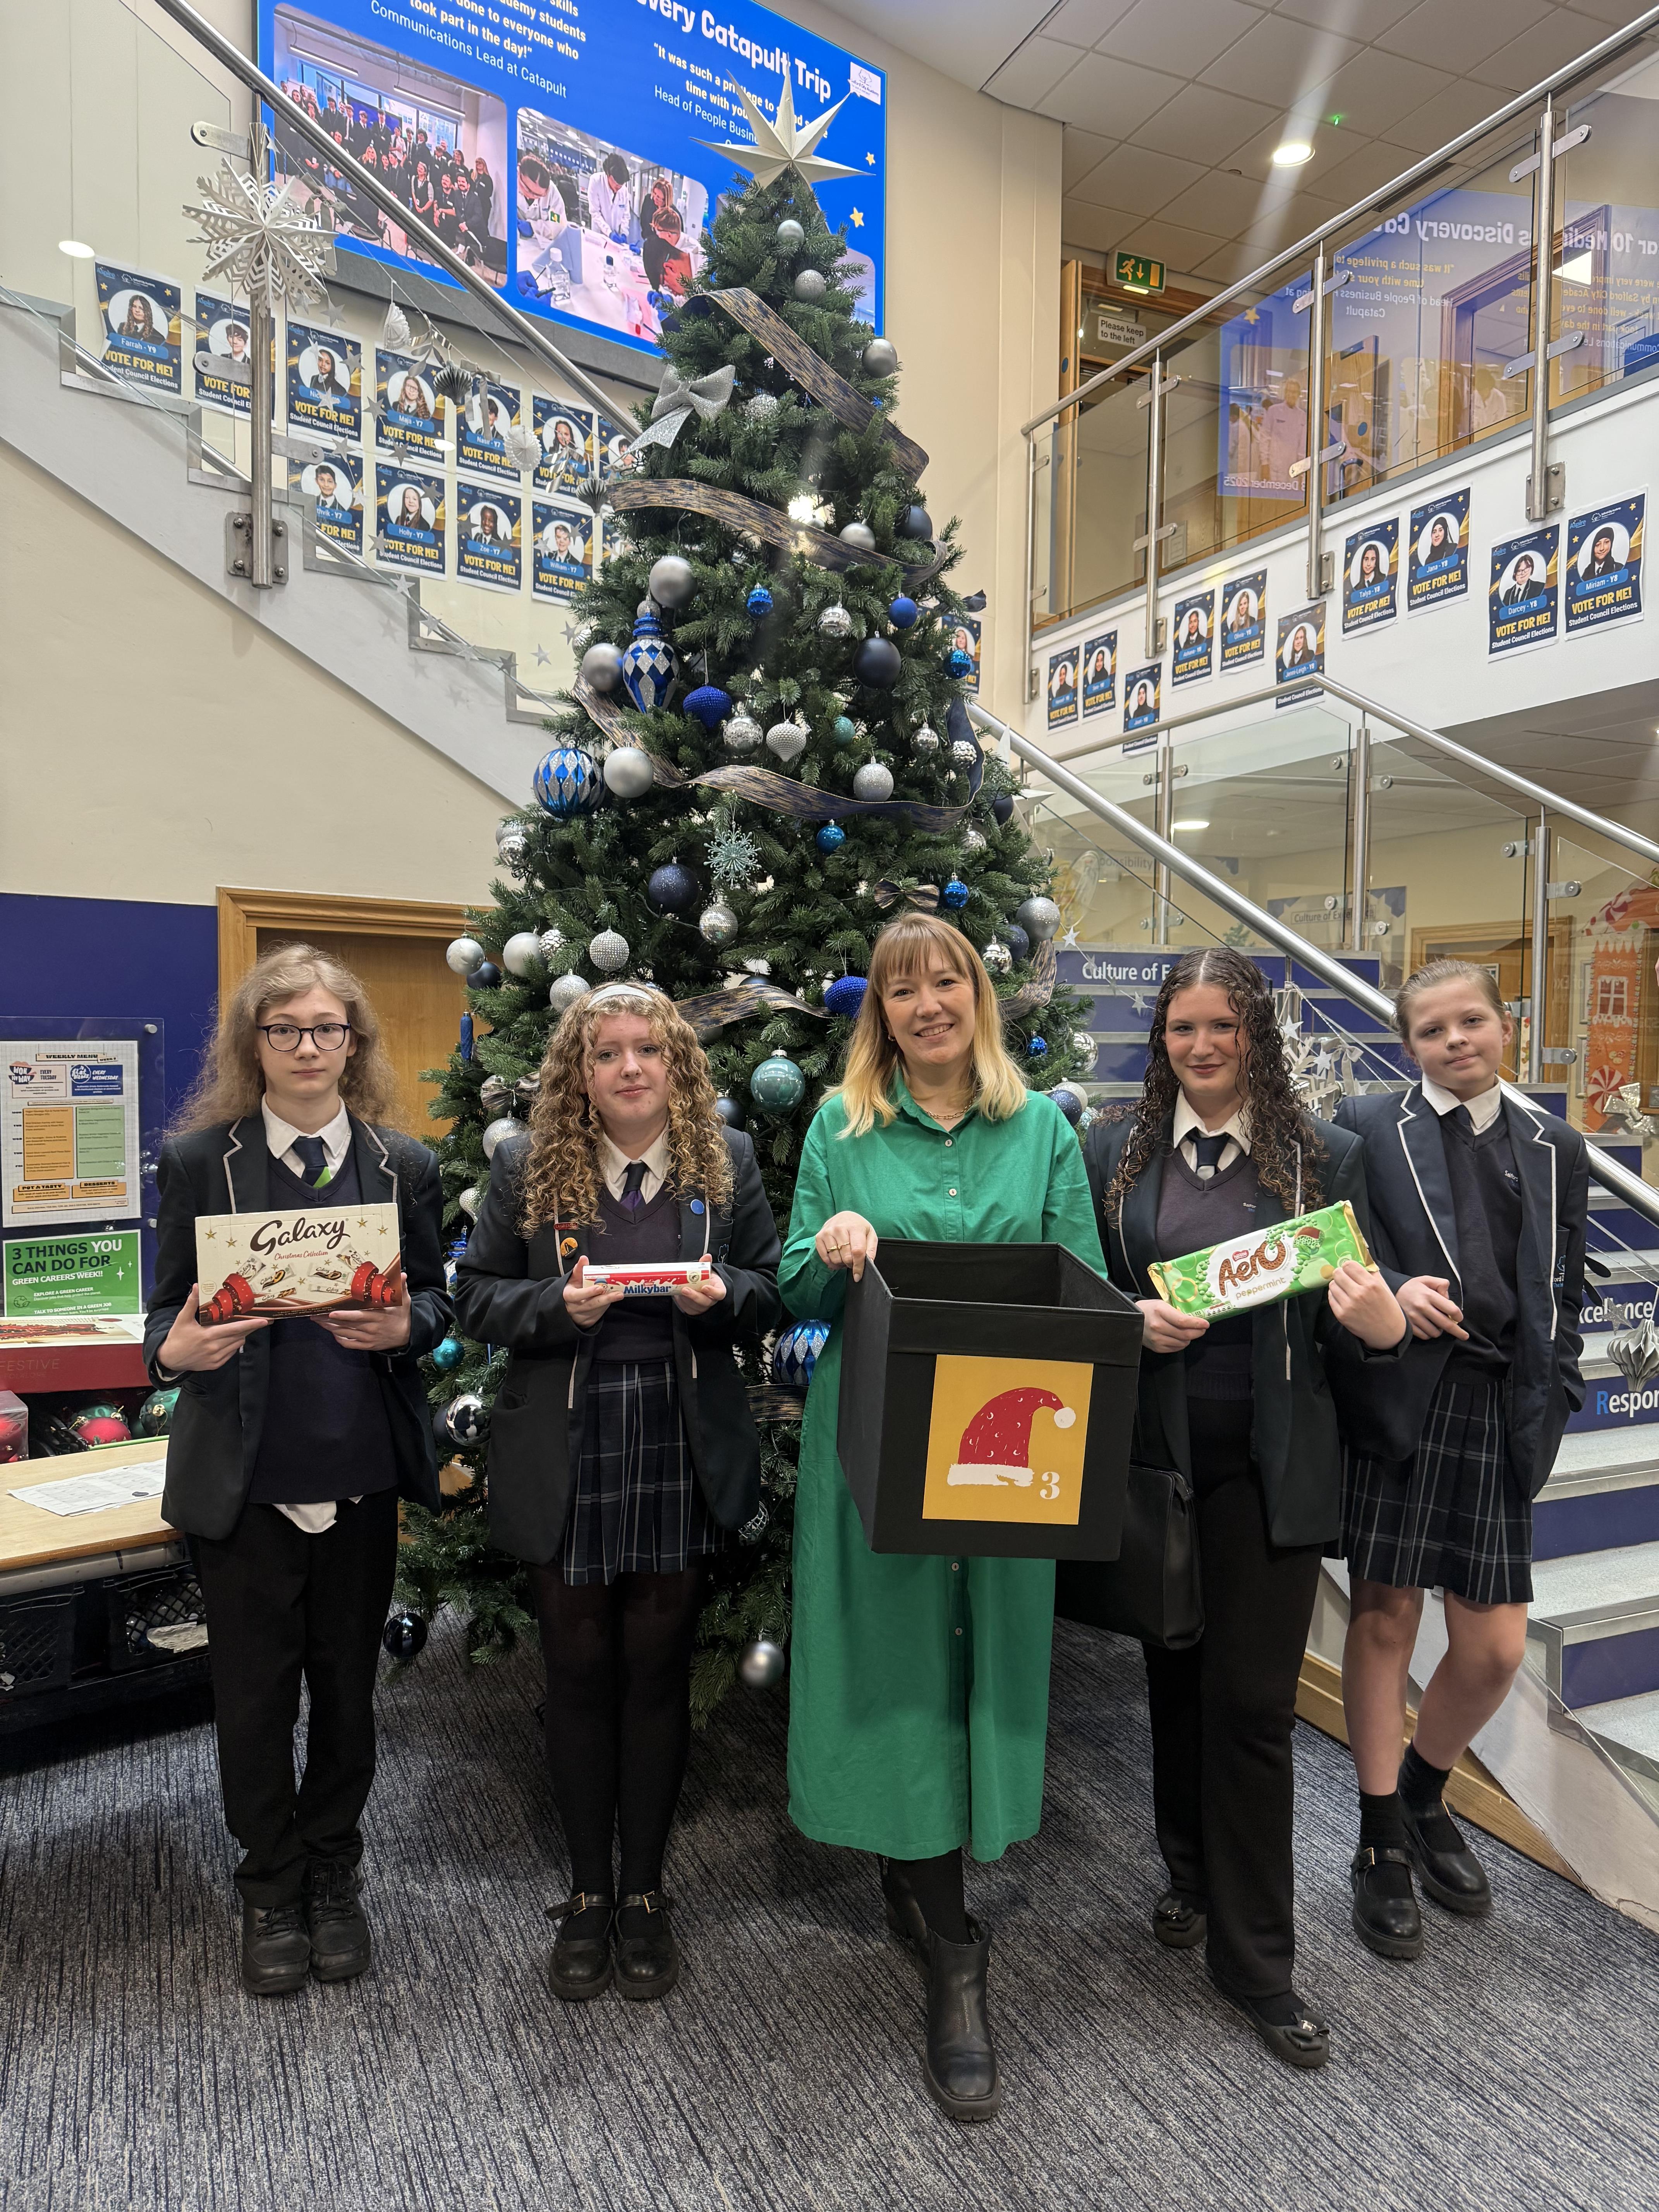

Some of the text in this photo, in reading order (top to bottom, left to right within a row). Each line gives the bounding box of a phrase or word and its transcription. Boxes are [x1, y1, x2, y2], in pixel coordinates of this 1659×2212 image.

[440, 10, 465, 30] part
[467, 19, 479, 36] in
[482, 27, 501, 46] the
[488, 7, 500, 23] to
[503, 17, 554, 48] everyone
[556, 41, 579, 59] who
[539, 12, 586, 42] students
[371, 0, 567, 99] Communications Lead at Catapult
[701, 10, 791, 77] Catapult
[795, 58, 831, 103] Trip
[668, 52, 687, 70] was
[690, 63, 713, 82] such
[715, 76, 721, 87] a
[765, 98, 775, 112] to
[655, 84, 726, 127] Head of People
[686, 80, 707, 100] time
[709, 93, 730, 111] with
[1101, 320, 1144, 337] Please keep
[1110, 333, 1121, 341] the
[1123, 336, 1135, 344] left
[121, 338, 142, 349] Farrah
[105, 350, 173, 378] VOTE FOR ME!
[125, 368, 178, 388] Council Elections
[295, 400, 354, 426] VOTE FOR ME!
[290, 412, 358, 437] Student Council Elections
[383, 425, 423, 445] VOTE FOR
[399, 528, 412, 538] Holly
[406, 543, 439, 560] FOR ME!
[480, 545, 489, 553] Zoe
[400, 554, 443, 569] Council Elections
[464, 554, 516, 576] VOTE FOR ME!
[550, 562, 567, 571] William
[1427, 565, 1438, 573] Jana
[460, 565, 519, 586] Student Council Elections
[539, 572, 574, 589] VOTE FOR
[1412, 570, 1461, 595] VOTE FOR ME!
[1586, 574, 1618, 590] Miriam Y8
[535, 582, 570, 596] Student Council
[1410, 584, 1466, 606] Student Council Elections
[1348, 595, 1390, 619] VOTE FOR ME!
[1508, 600, 1537, 615] Darcey Y8
[1572, 586, 1632, 615] VOTE FOR ME!
[1344, 608, 1395, 629] Student Council Elections
[1496, 611, 1551, 638] VOTE FOR ME!
[1568, 602, 1638, 627] Student Council Elections
[1492, 626, 1554, 649] Student Council Elections
[1294, 911, 1331, 922] Culture of
[1082, 961, 1158, 981] Culture of
[250, 1217, 350, 1255] Galaxy
[12, 1239, 122, 1260] 3 THINGS YOU
[275, 1250, 328, 1260] Christmas Collection
[12, 1255, 112, 1274] CAN DO FOR
[12, 1271, 103, 1286] GREEN CAREERS WEEK!!
[1236, 1277, 1286, 1300] peppermint
[623, 1285, 672, 1294] Milkybar
[1040, 1472, 1060, 1499] 3
